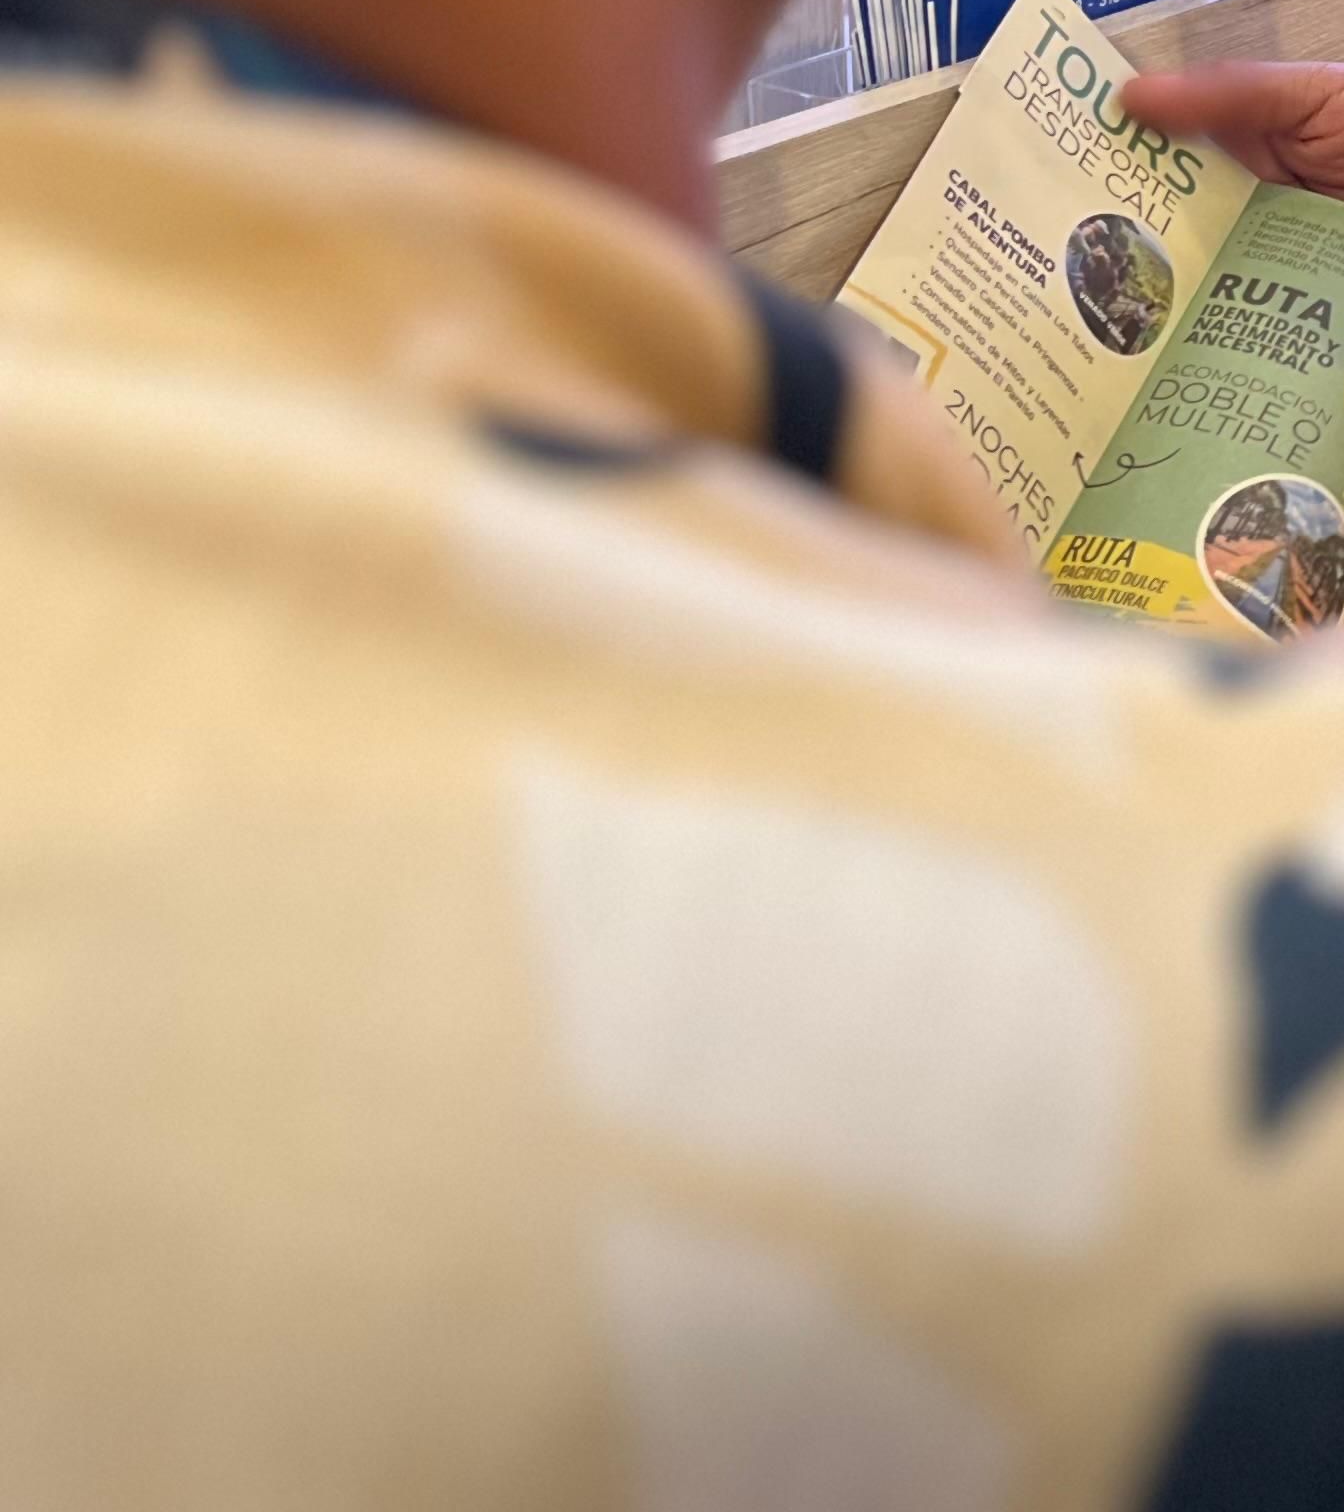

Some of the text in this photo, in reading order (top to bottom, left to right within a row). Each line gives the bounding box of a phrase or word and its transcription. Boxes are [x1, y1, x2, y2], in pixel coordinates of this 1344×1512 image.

[1020, 50, 1181, 214] TRANSPORTE
[1033, 8, 1204, 196] TOURS
[1004, 70, 1172, 236] DESDE CALI
[943, 187, 1048, 290] DE AVENTURA
[948, 169, 1056, 273] CABAL POMBO
[936, 251, 977, 292] Sendero
[979, 288, 1018, 330] Cascada
[945, 237, 992, 284] Quebrada
[1201, 303, 1341, 354] IDENTIDAD Y
[1209, 273, 1333, 331] RUTA
[1184, 331, 1310, 376] ANCESTRAL
[1192, 318, 1335, 369] NACIMIENTO
[1150, 378, 1321, 446] DOBLE O
[1061, 535, 1138, 569] RUTA
[1120, 571, 1170, 595] DULCE
